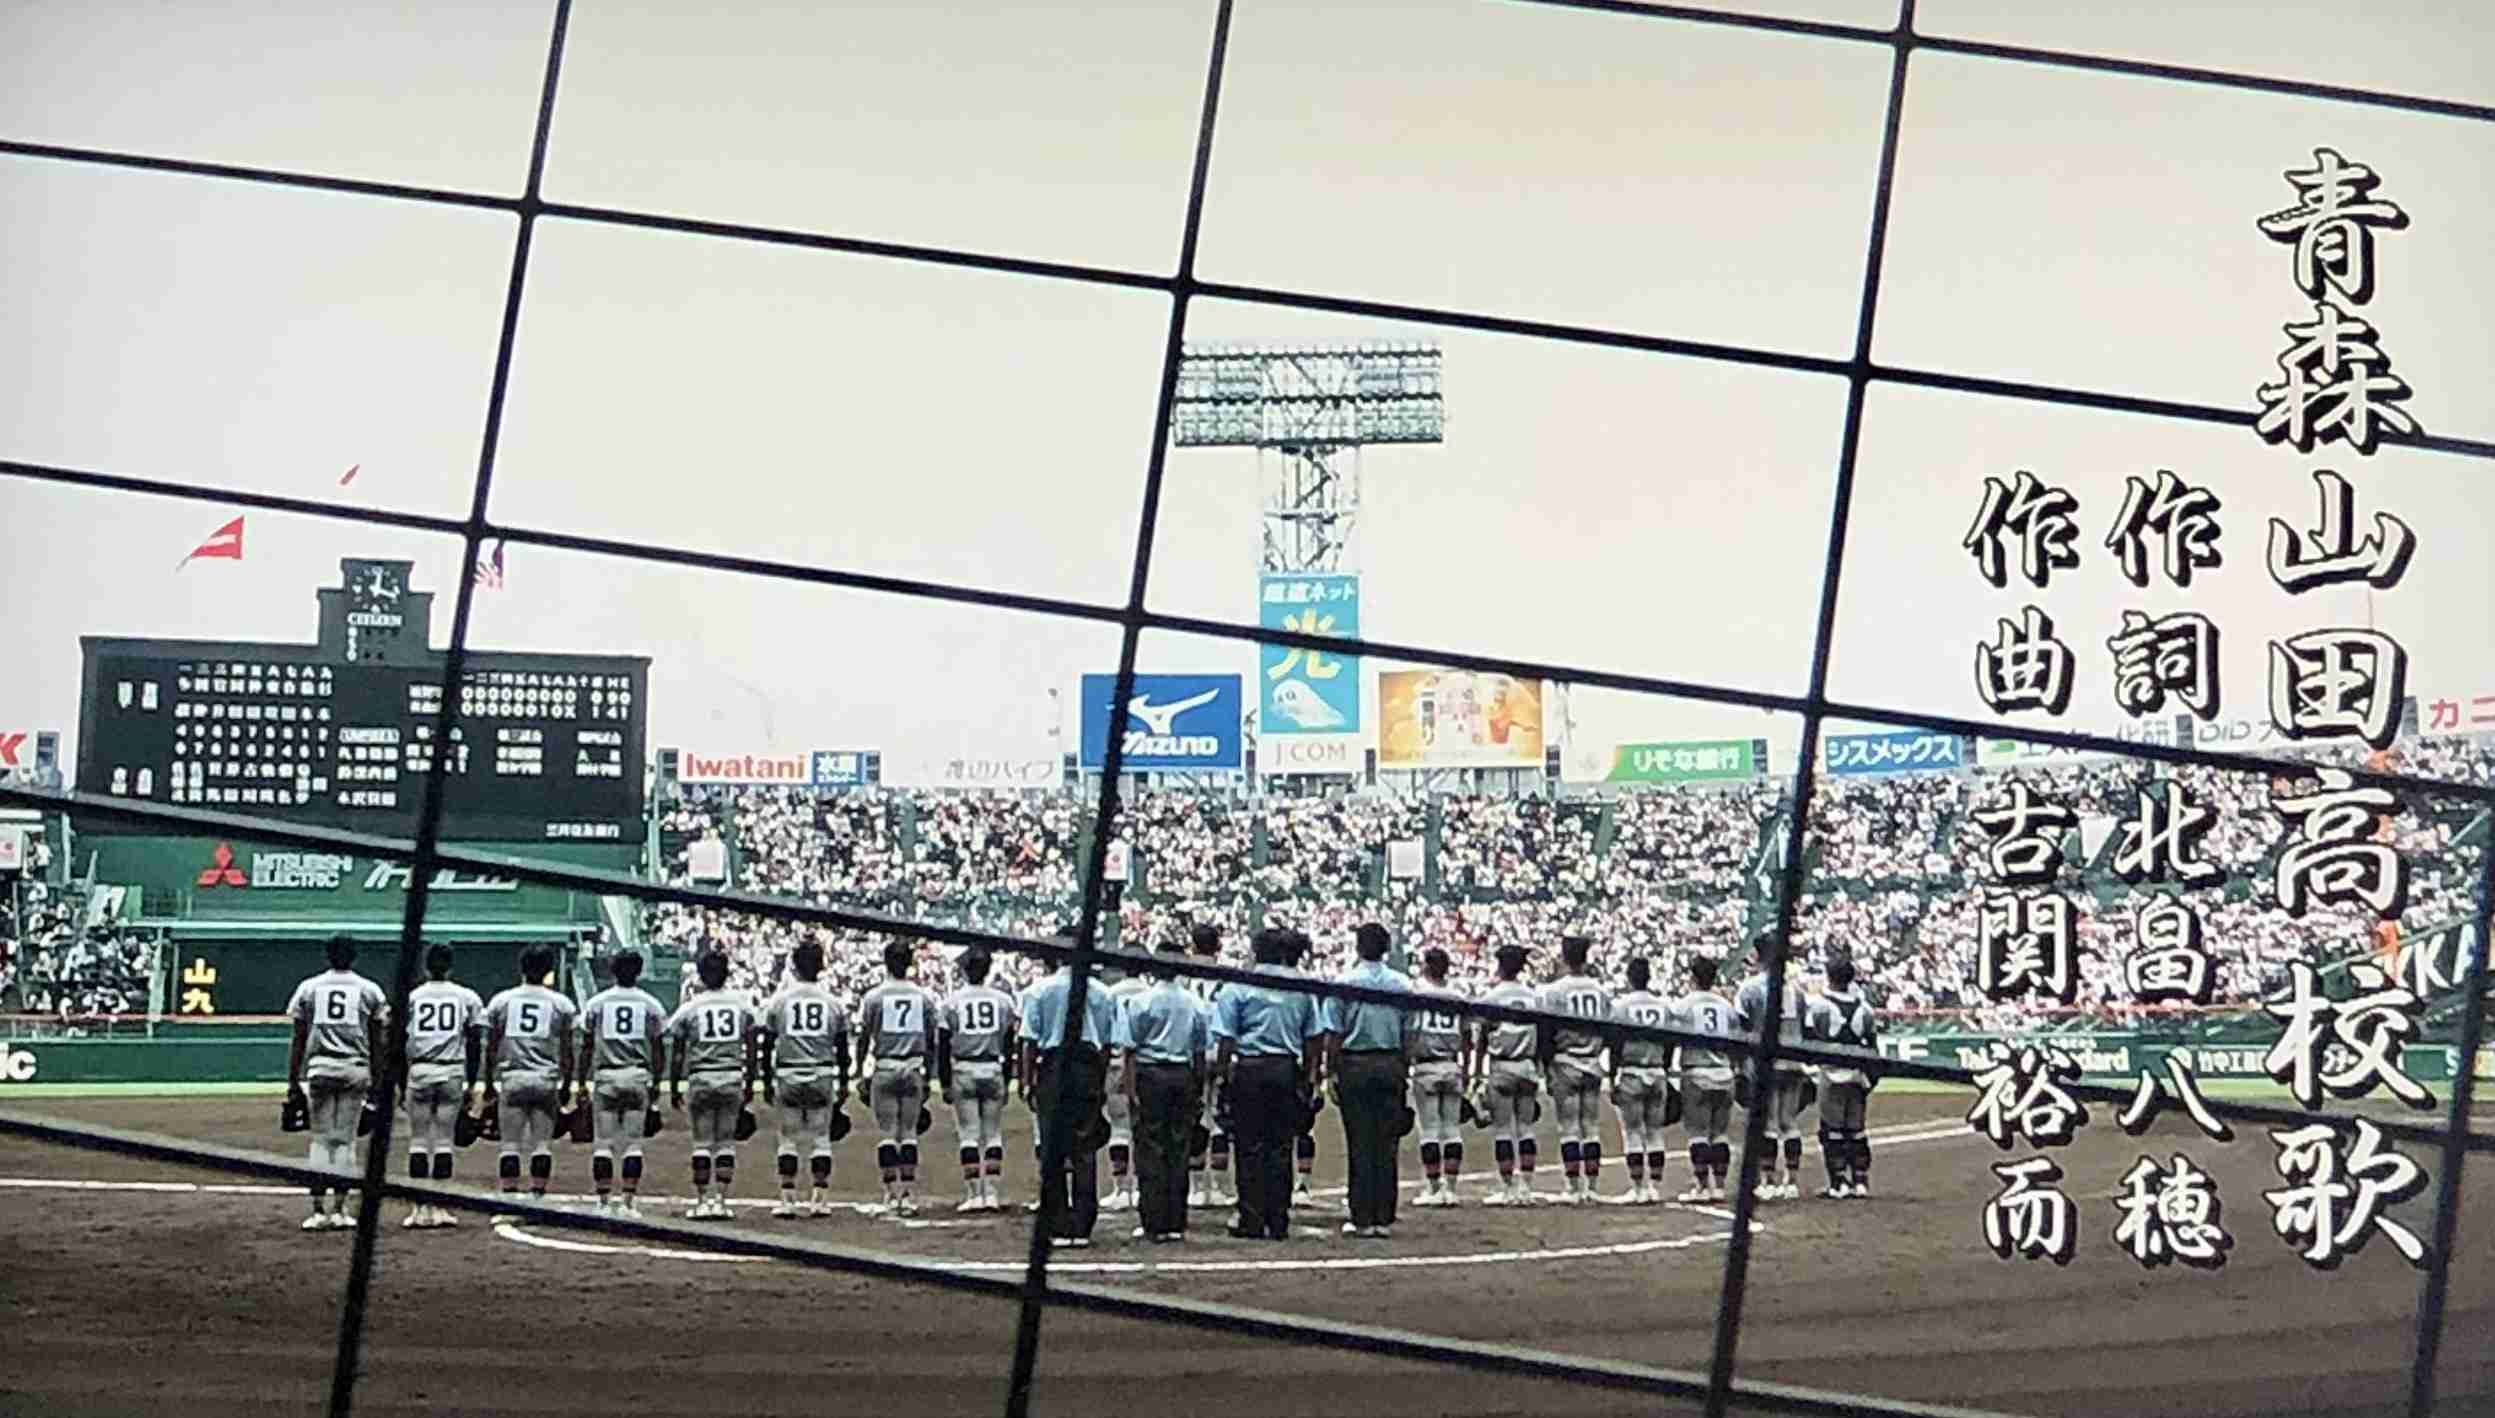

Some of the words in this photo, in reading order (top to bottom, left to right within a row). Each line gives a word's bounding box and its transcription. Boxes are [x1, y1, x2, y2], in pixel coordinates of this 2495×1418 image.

[1828, 736, 1955, 767] シスメックス
[686, 753, 806, 780] Iwatani
[184, 959, 216, 1014] 山九
[327, 991, 346, 1019] 6
[418, 1003, 456, 1031] 20
[519, 1003, 540, 1032] 5
[791, 1002, 823, 1031] 18
[894, 1000, 911, 1028] 7
[964, 1001, 995, 1030] 19
[1572, 994, 1597, 1018] 10
[616, 1006, 634, 1034] 8
[704, 1009, 735, 1040] 13
[1703, 1007, 1718, 1033] 3
